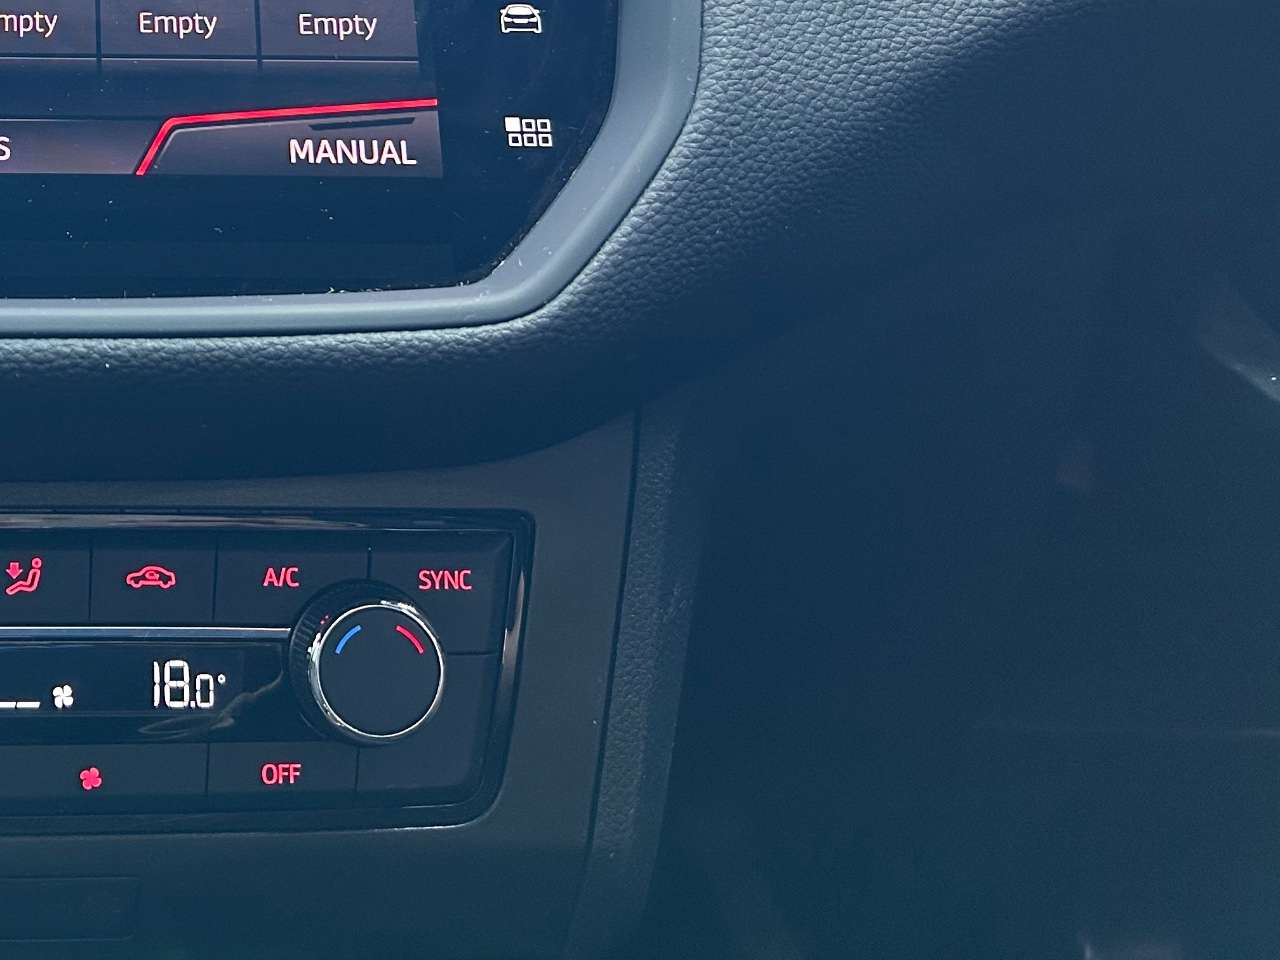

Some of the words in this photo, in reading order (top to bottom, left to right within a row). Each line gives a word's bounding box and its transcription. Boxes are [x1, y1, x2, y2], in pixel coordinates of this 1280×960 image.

[139, 11, 218, 40] Empty
[298, 13, 378, 41] Empty
[289, 138, 418, 165] MANUAL
[262, 567, 300, 588] A/C
[418, 569, 473, 591] SYNC
[261, 763, 302, 785] OFF
